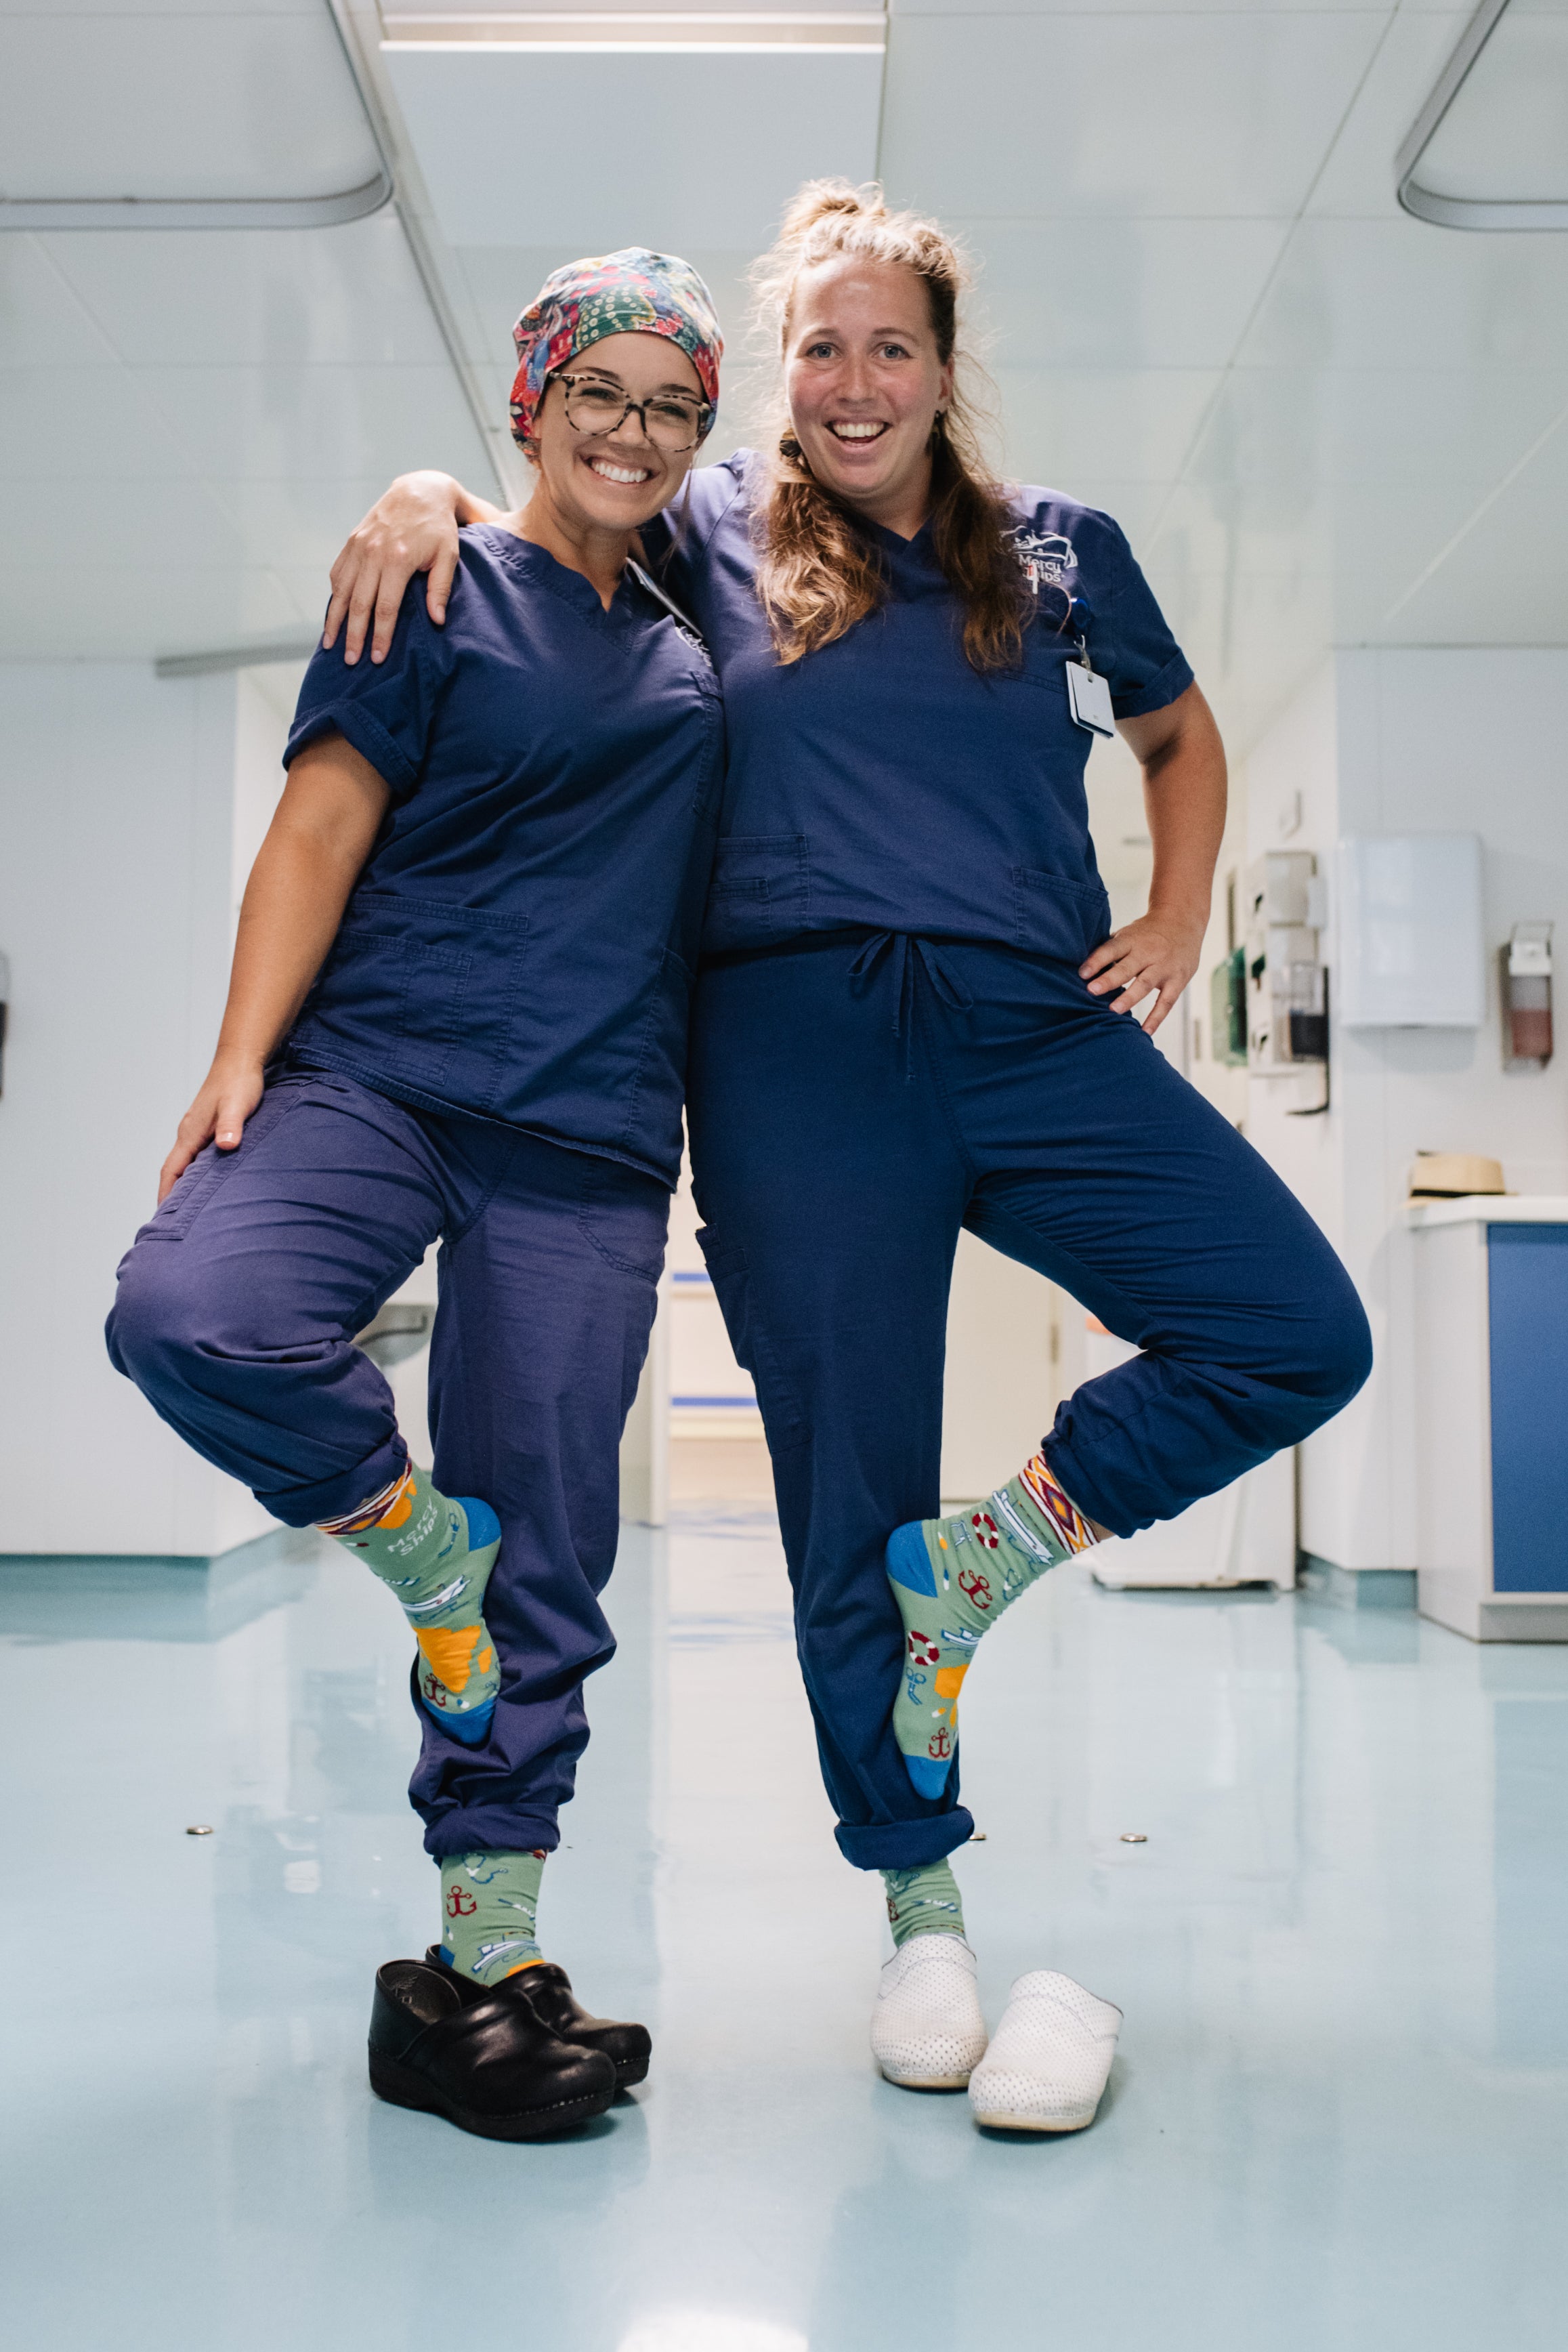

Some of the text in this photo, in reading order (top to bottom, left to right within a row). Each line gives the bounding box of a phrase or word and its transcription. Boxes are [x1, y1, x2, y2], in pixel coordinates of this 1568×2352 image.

[1018, 554, 1062, 574] Mercy
[387, 1496, 433, 1552] Mercy
[400, 1507, 438, 1556] Ships
